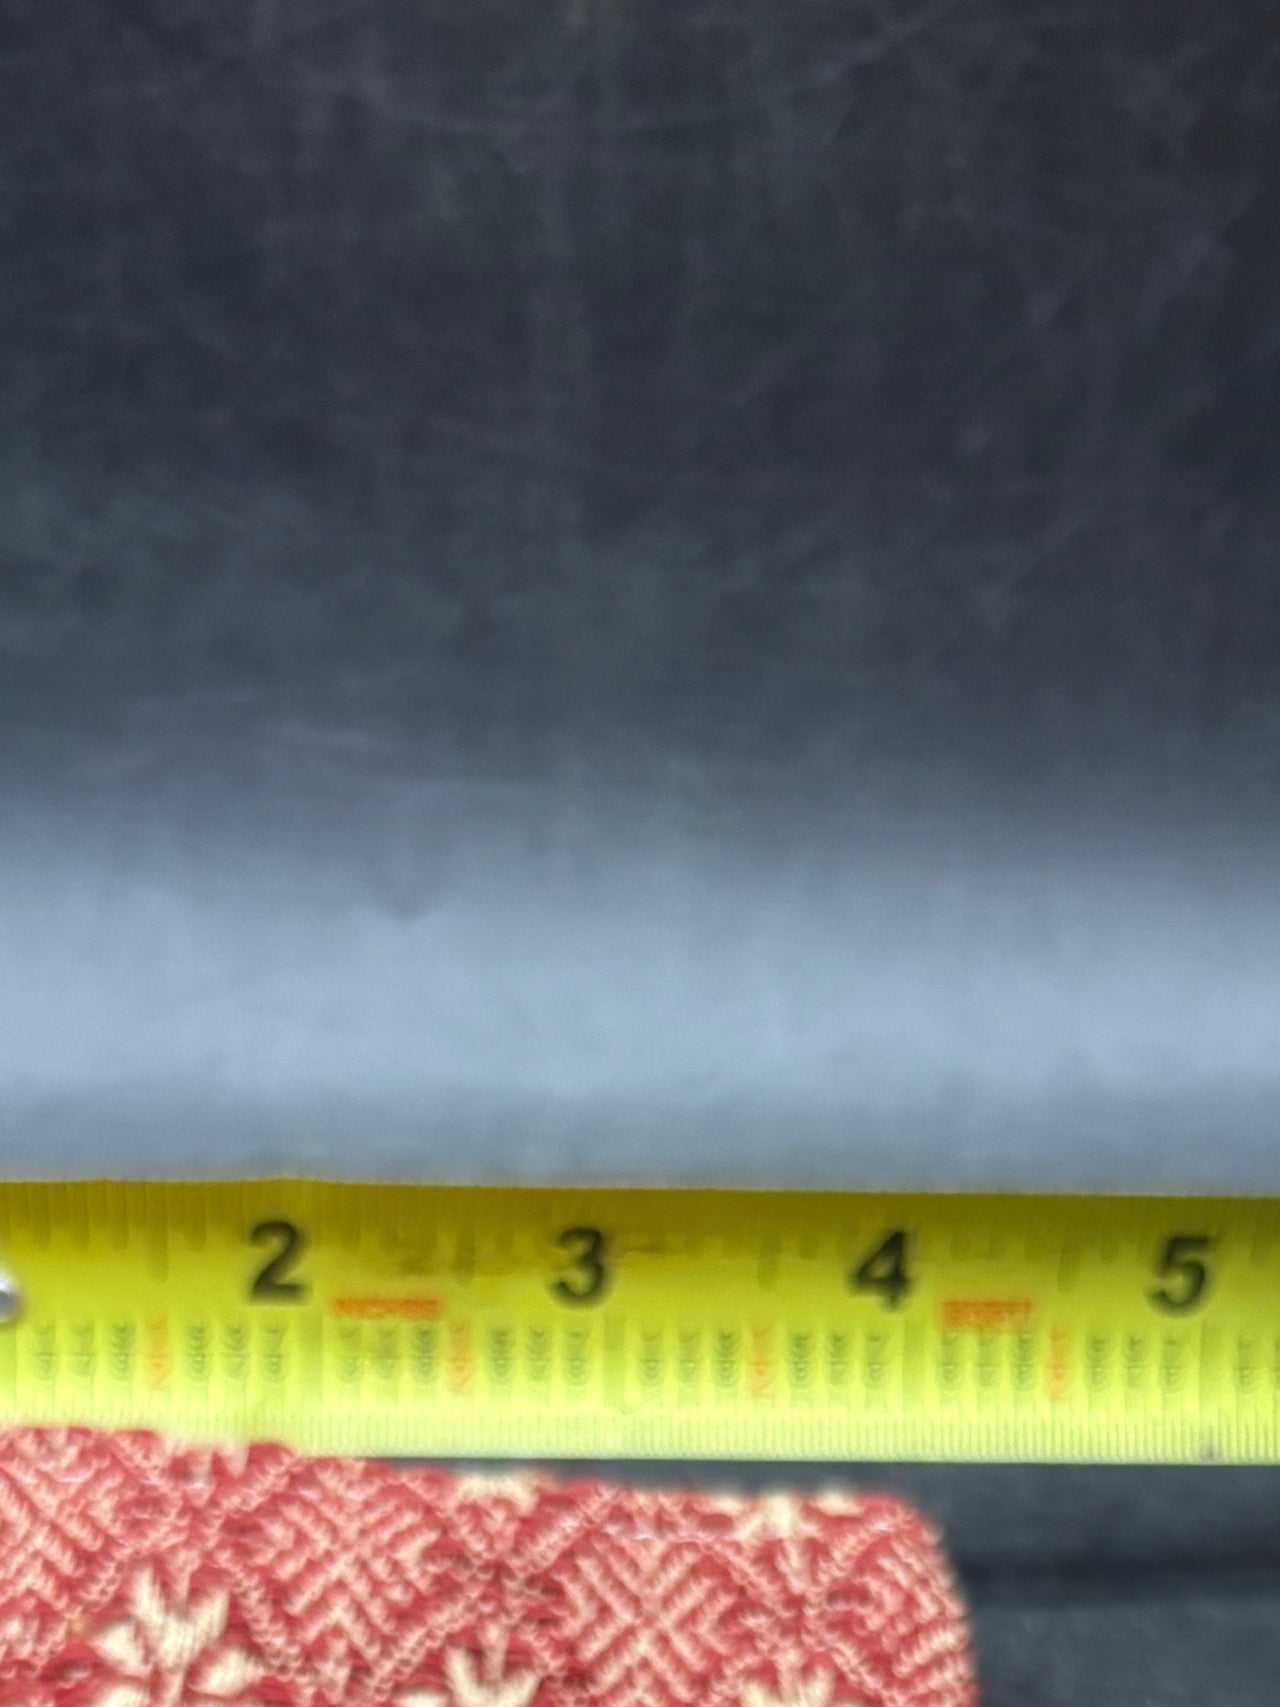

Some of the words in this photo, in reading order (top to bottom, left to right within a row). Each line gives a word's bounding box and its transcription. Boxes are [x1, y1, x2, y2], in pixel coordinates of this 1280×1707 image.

[248, 1218, 310, 1305] 2
[552, 1225, 612, 1309] 3
[848, 1228, 914, 1313] 4
[1146, 1234, 1214, 1318] 5
